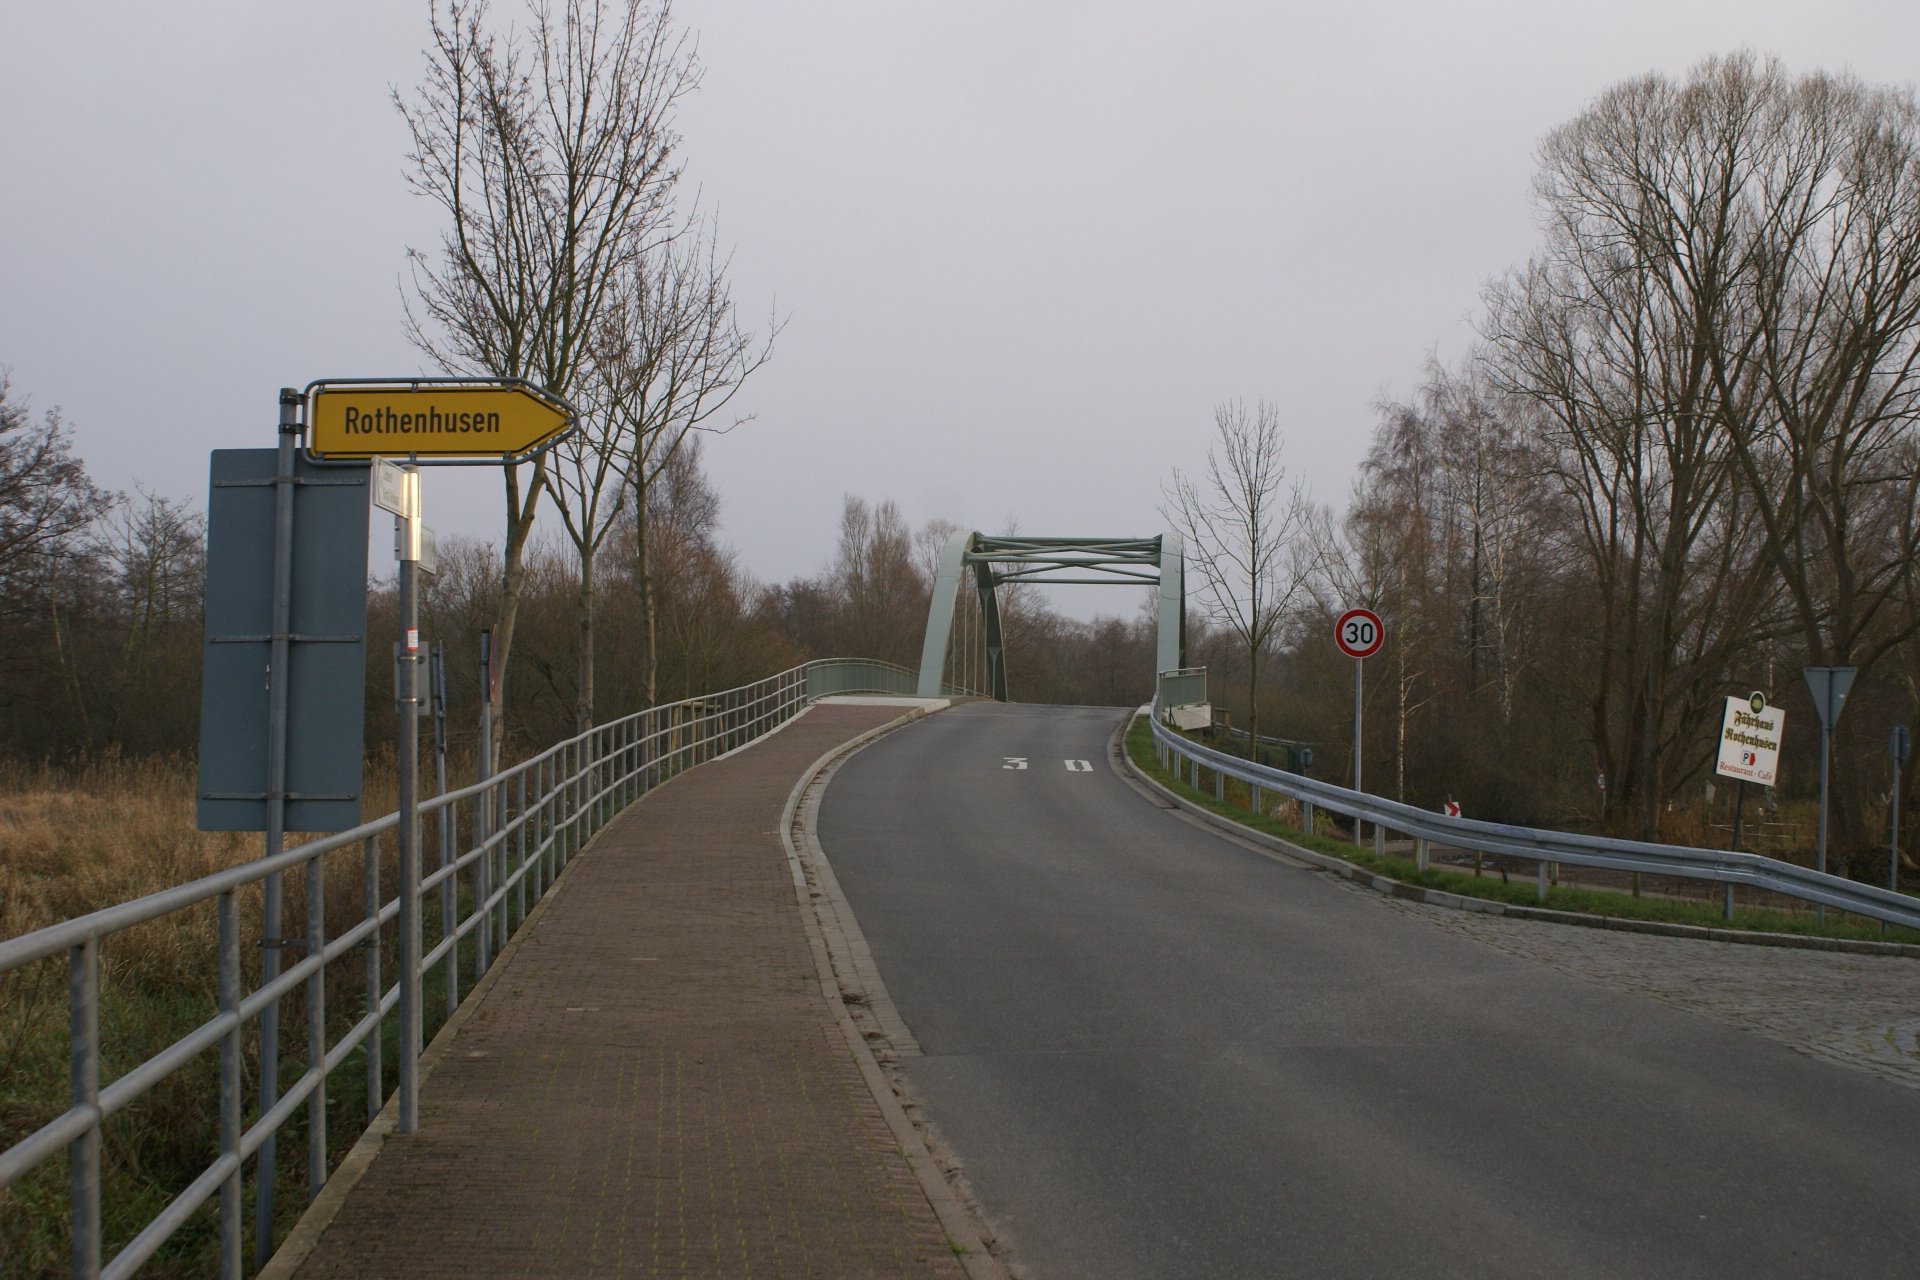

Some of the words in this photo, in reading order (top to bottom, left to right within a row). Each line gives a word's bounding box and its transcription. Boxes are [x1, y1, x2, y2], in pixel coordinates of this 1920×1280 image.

[345, 405, 500, 434] Rothenhusen
[1346, 623, 1373, 644] 30
[1734, 711, 1774, 731] Fährhaus
[1725, 728, 1777, 751] Rothenhusen
[1743, 753, 1749, 762] P
[1720, 761, 1753, 776] Restaurant
[1757, 770, 1773, 781] Café
